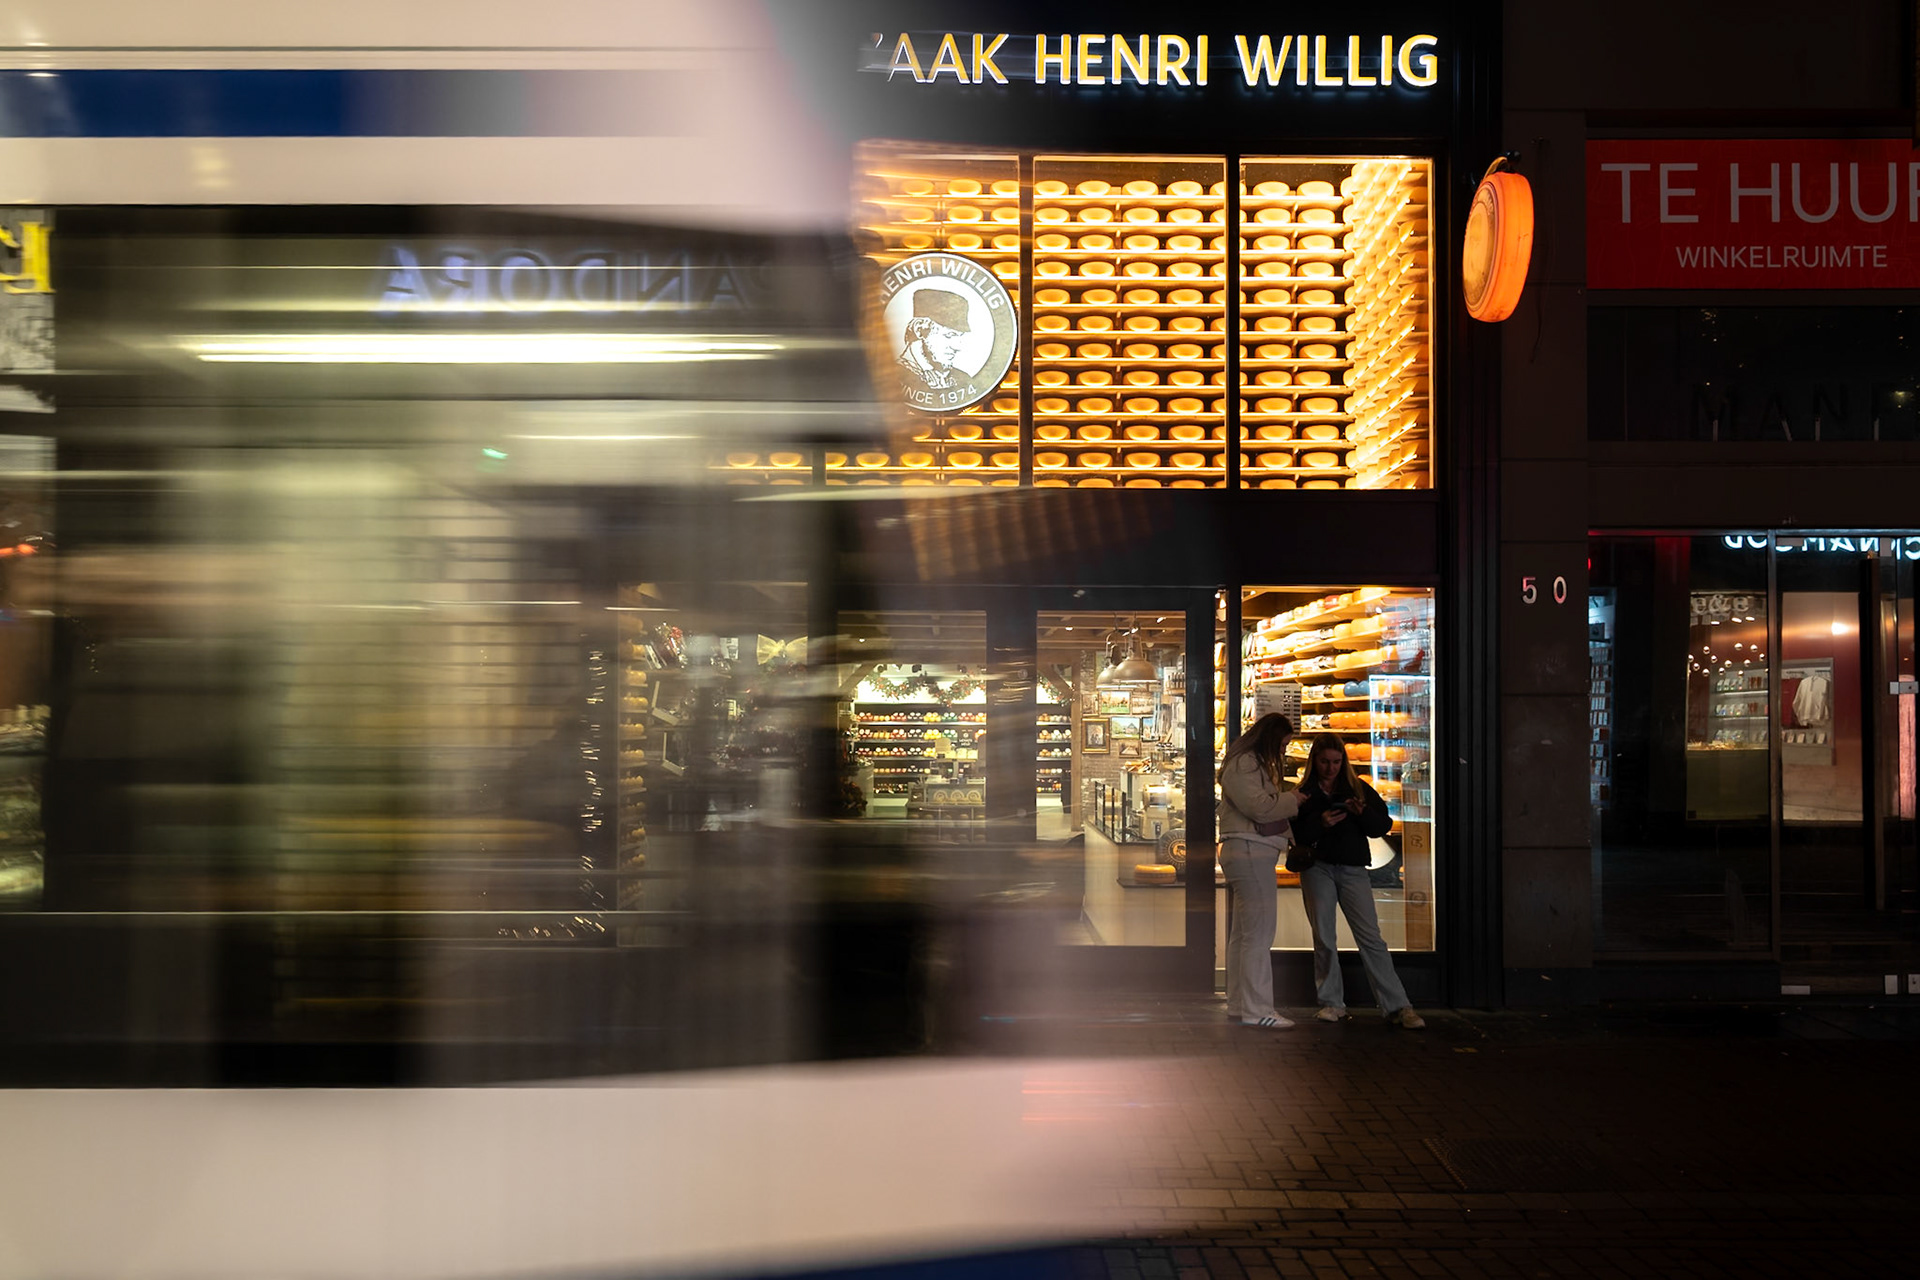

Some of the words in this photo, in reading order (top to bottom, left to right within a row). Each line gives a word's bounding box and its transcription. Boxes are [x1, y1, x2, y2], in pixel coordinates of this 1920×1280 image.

[872, 33, 1009, 84] AAK
[1035, 34, 1208, 86] HENRI
[1235, 34, 1439, 87] WILLIG
[1601, 163, 1699, 223] TE
[1730, 162, 1920, 223] HUU
[1676, 245, 1888, 268] WINKELRUIMTE
[942, 258, 1005, 310] WILLIG
[900, 381, 934, 405] INCE
[939, 384, 977, 404] 1974
